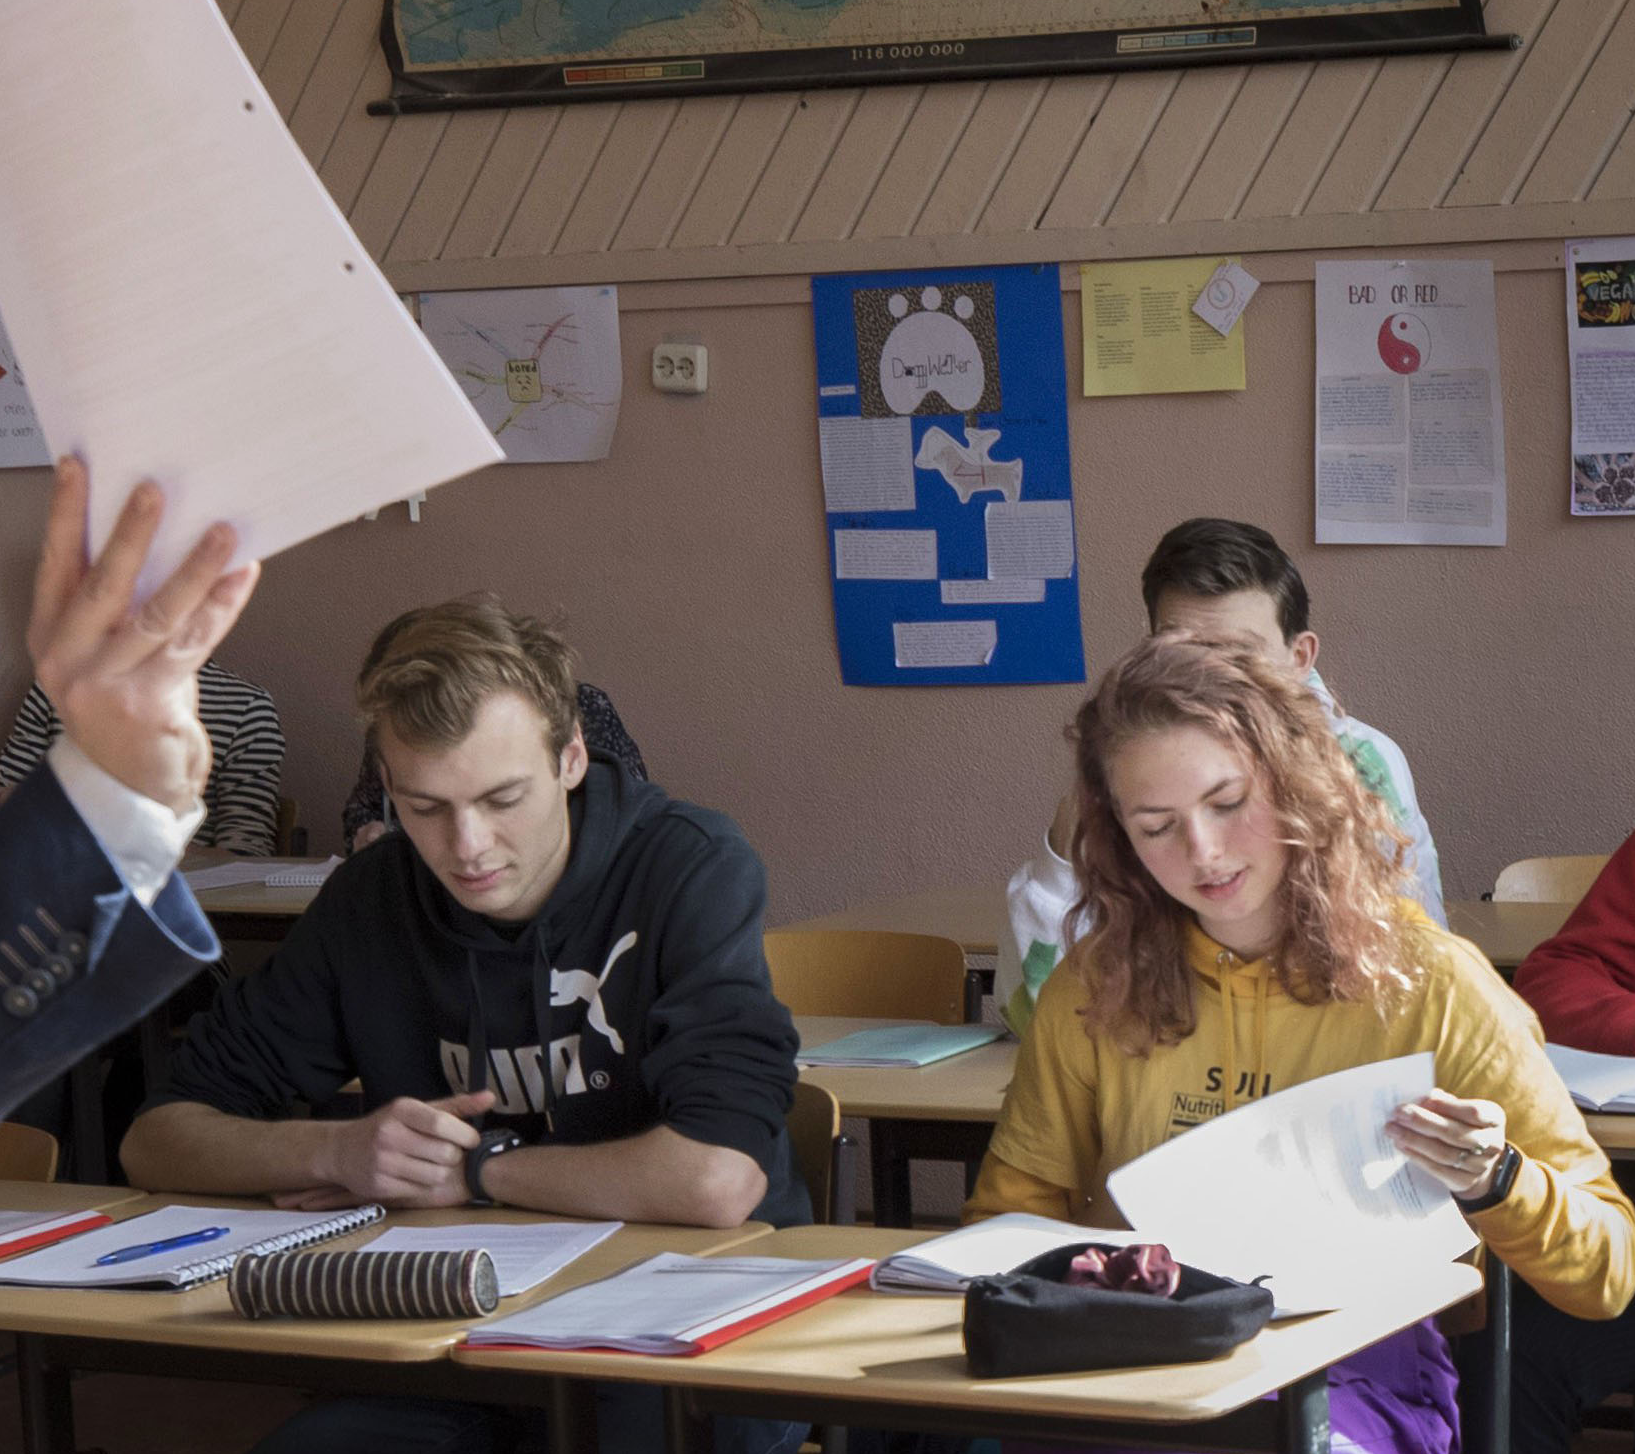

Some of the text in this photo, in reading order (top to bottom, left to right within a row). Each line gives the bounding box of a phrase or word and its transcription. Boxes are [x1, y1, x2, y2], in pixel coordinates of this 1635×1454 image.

[852, 43, 965, 61] 1:16 000 000
[1349, 284, 1438, 304] BAD OR RED
[508, 363, 537, 373] bored
